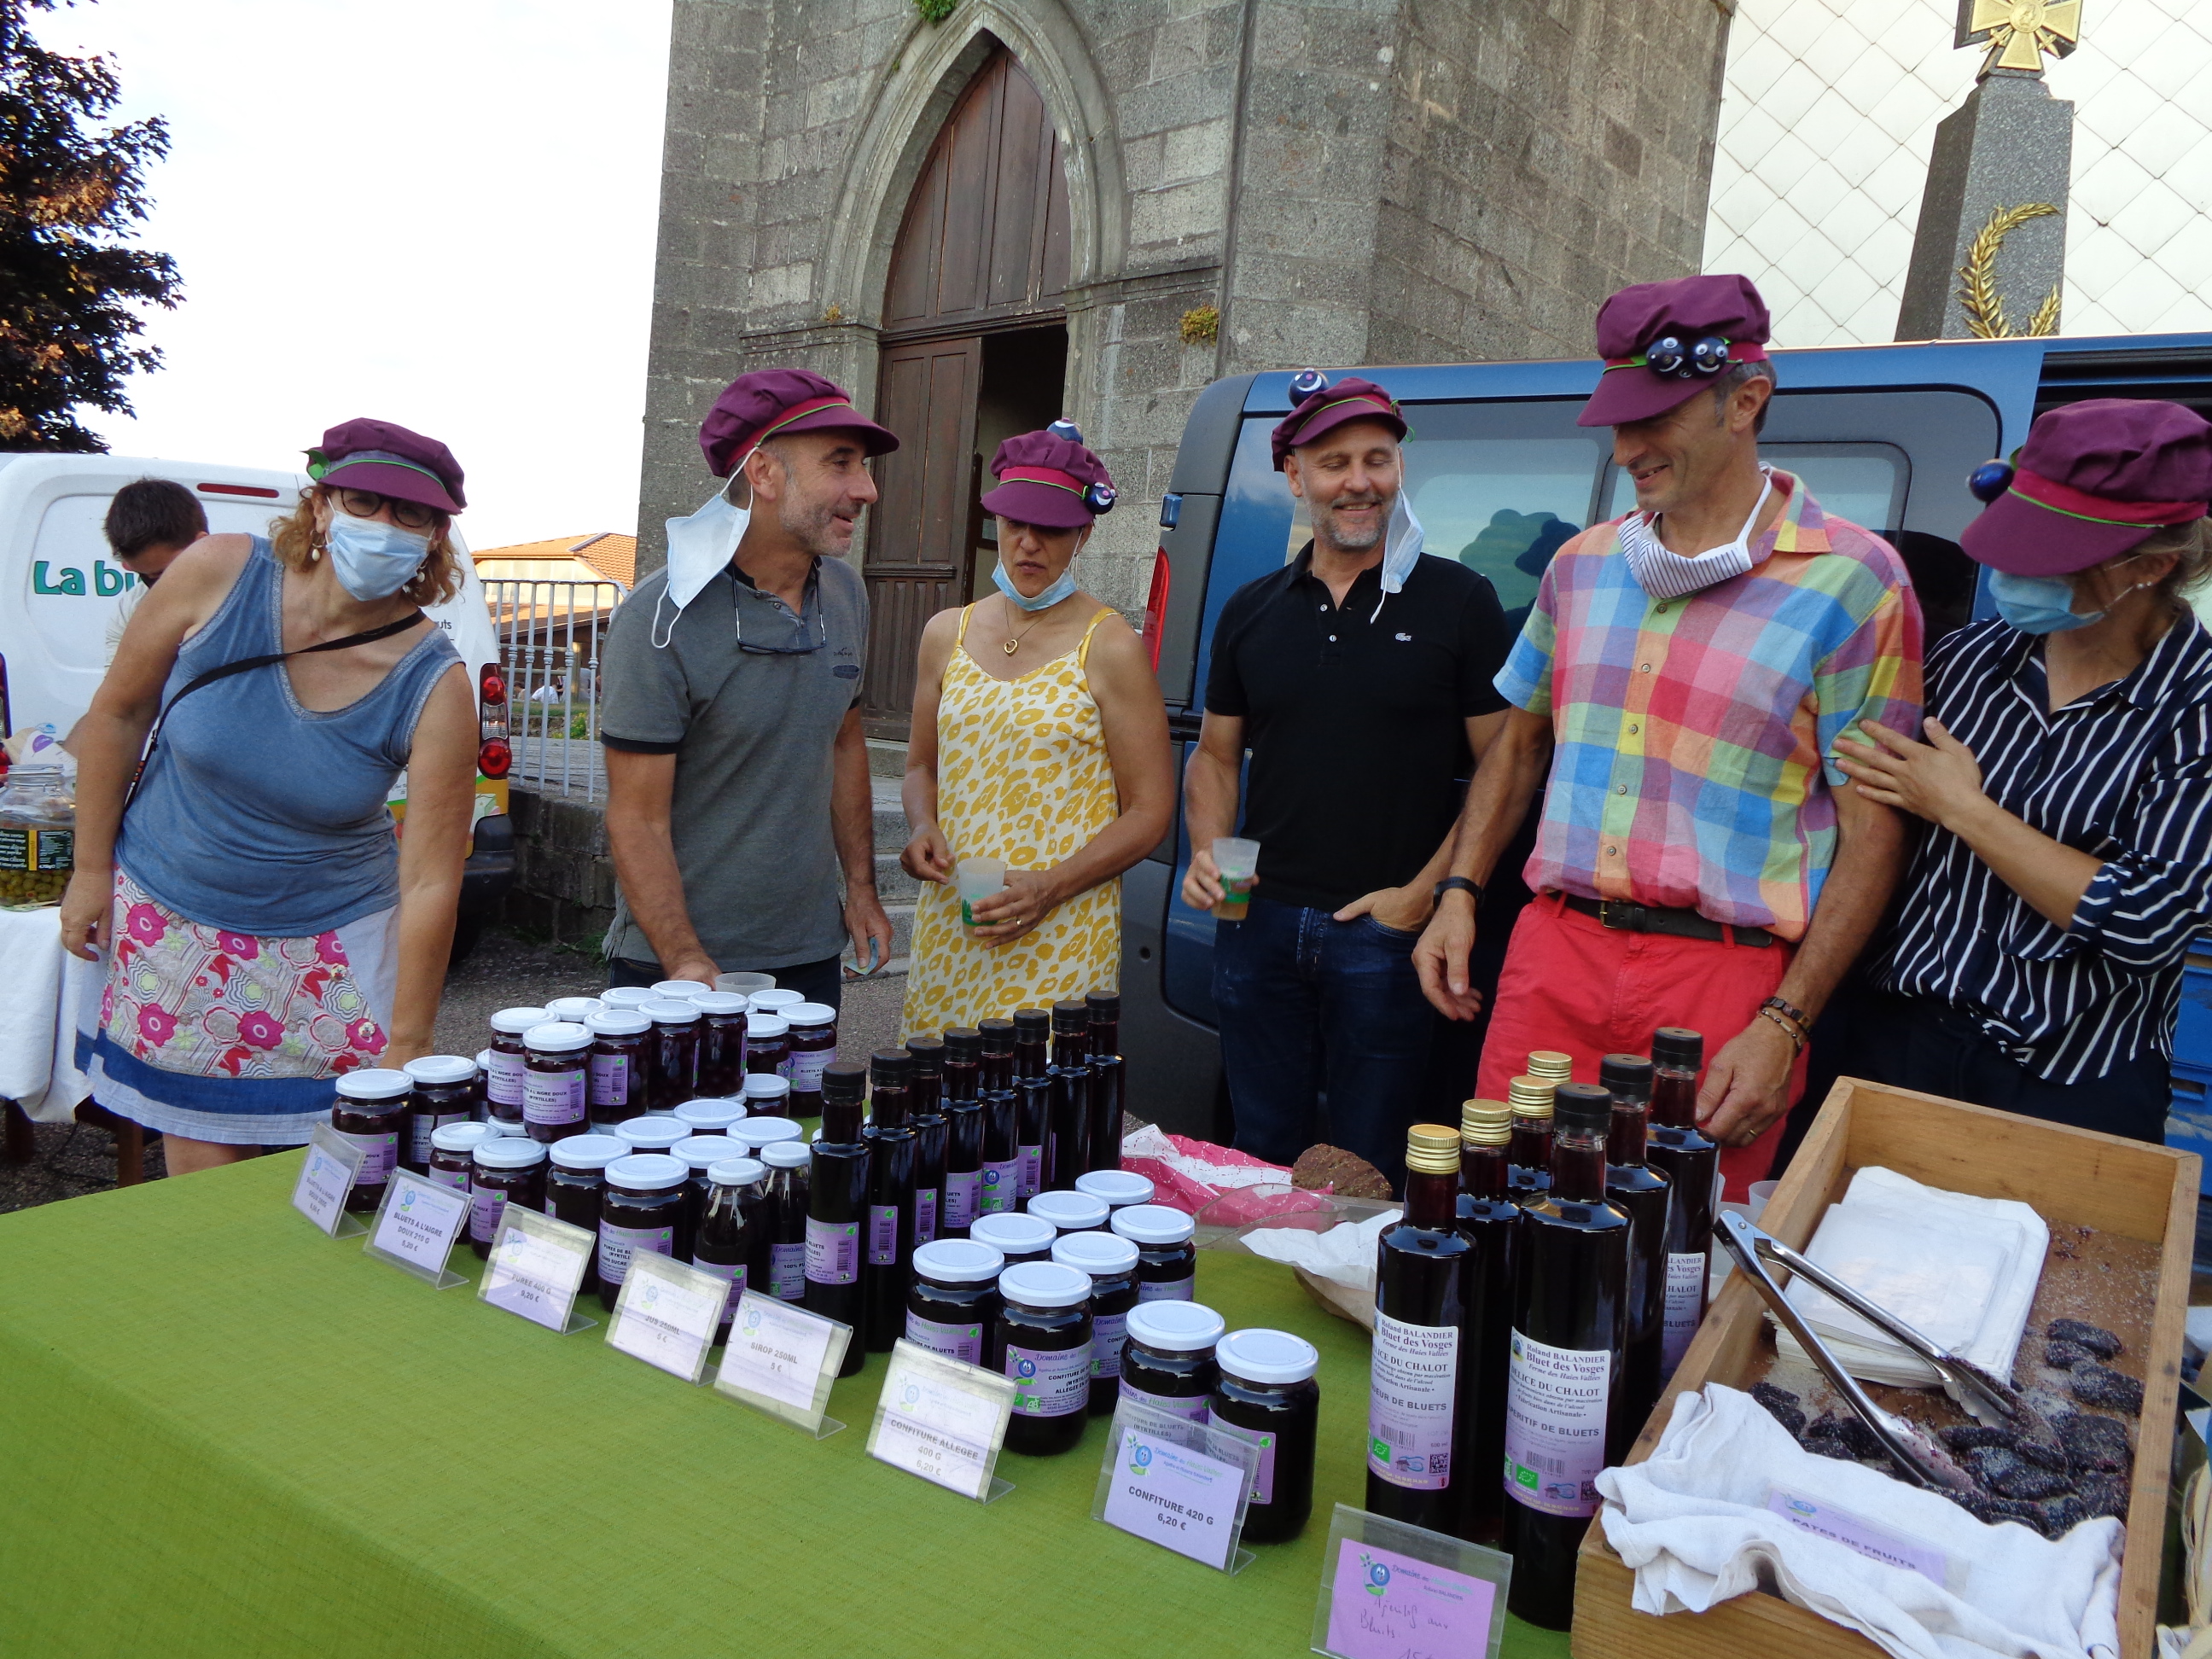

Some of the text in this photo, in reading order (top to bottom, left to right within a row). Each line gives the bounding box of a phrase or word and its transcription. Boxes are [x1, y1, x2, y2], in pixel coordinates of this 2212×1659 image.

[33, 560, 135, 597] La bi
[393, 1212, 415, 1225] BLUETS
[421, 1222, 443, 1237] L'AIGRE
[398, 1225, 414, 1237] DOUX
[1676, 1265, 1701, 1276] Vosges
[512, 1273, 533, 1288] PUREE
[533, 1283, 544, 1293] 400
[521, 1289, 534, 1301] 9,20
[645, 1316, 680, 1336] JUS 250ML
[1381, 1318, 1453, 1339] Roland BALANDIER
[1107, 1334, 1129, 1343] CONFITU
[1381, 1327, 1452, 1352] Bluet des Vosges
[1382, 1338, 1397, 1350] Ferme
[751, 1342, 798, 1365] SIROP 250ML
[932, 1346, 954, 1354] BLUETS
[1034, 1353, 1068, 1361] Domaine
[1527, 1344, 1606, 1363] Roland BALANDIER
[770, 1362, 776, 1371] 5
[1390, 1356, 1403, 1366] DU
[1405, 1361, 1448, 1372] CHALOT
[1526, 1352, 1604, 1376] Bluet des Vosges
[1528, 1364, 1546, 1375] Ferme
[1048, 1370, 1080, 1381] CONFITURE
[1055, 1384, 1079, 1394] ALLEGEE
[1399, 1382, 1430, 1393] Artisanale
[1538, 1381, 1552, 1391] DU
[1555, 1386, 1600, 1397] CHALOT
[1149, 1398, 1170, 1408] Haies
[1392, 1396, 1405, 1406] DE
[1406, 1401, 1447, 1411] BLUETS
[1517, 1394, 1582, 1418] Fabrication Artisanale
[1541, 1423, 1555, 1434] DE
[1558, 1428, 1599, 1437] BLUETS
[891, 1419, 979, 1460] CONFITURE ALLEGEE
[918, 1446, 934, 1457] 400
[1155, 1447, 1179, 1461] Domaine
[917, 1460, 941, 1476] 6,20 €
[1128, 1486, 1214, 1525] CONFITURE 420 G
[1157, 1513, 1187, 1531] 6,20 €
[1792, 1518, 1837, 1539] PATES
[1841, 1536, 1860, 1548] DE
[1864, 1545, 1916, 1569] FRUITS
[1392, 1564, 1421, 1580] Domaine
[1428, 1616, 1448, 1629] aux
